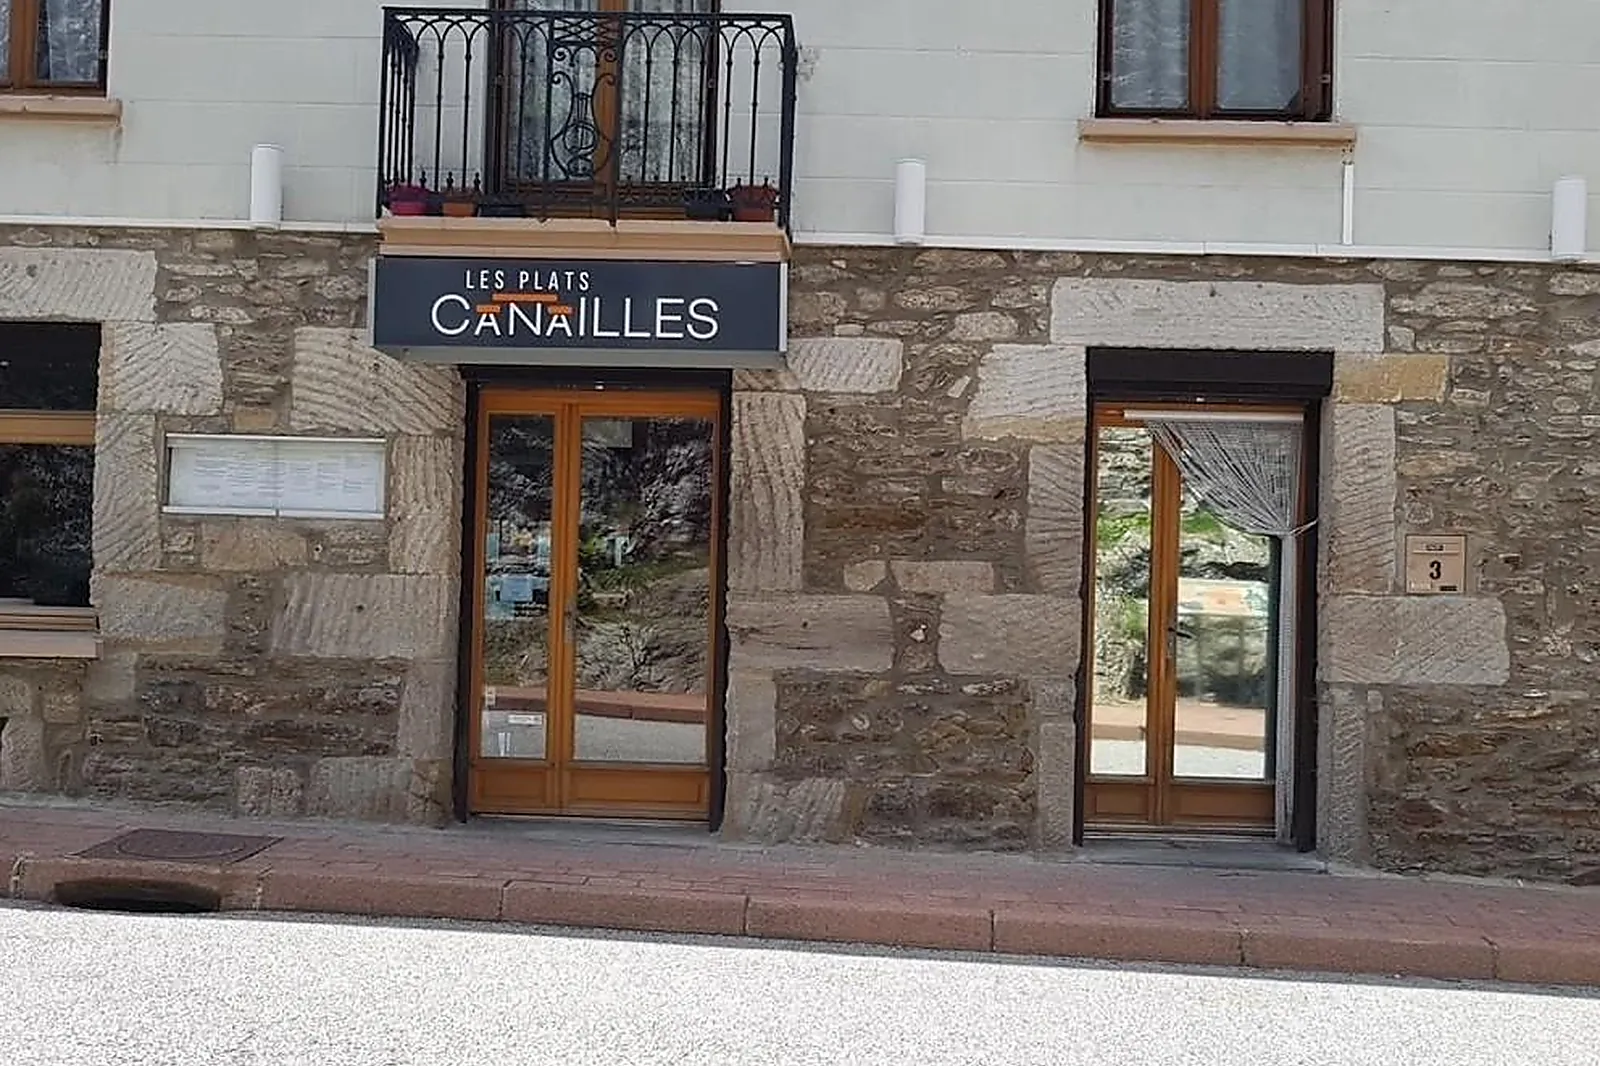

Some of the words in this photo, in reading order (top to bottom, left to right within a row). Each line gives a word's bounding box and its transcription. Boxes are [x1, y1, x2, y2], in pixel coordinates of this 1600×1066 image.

[465, 269, 505, 291] LES
[519, 270, 591, 292] PLATS
[430, 293, 720, 341] CANAILLES
[1429, 560, 1442, 580] 3
